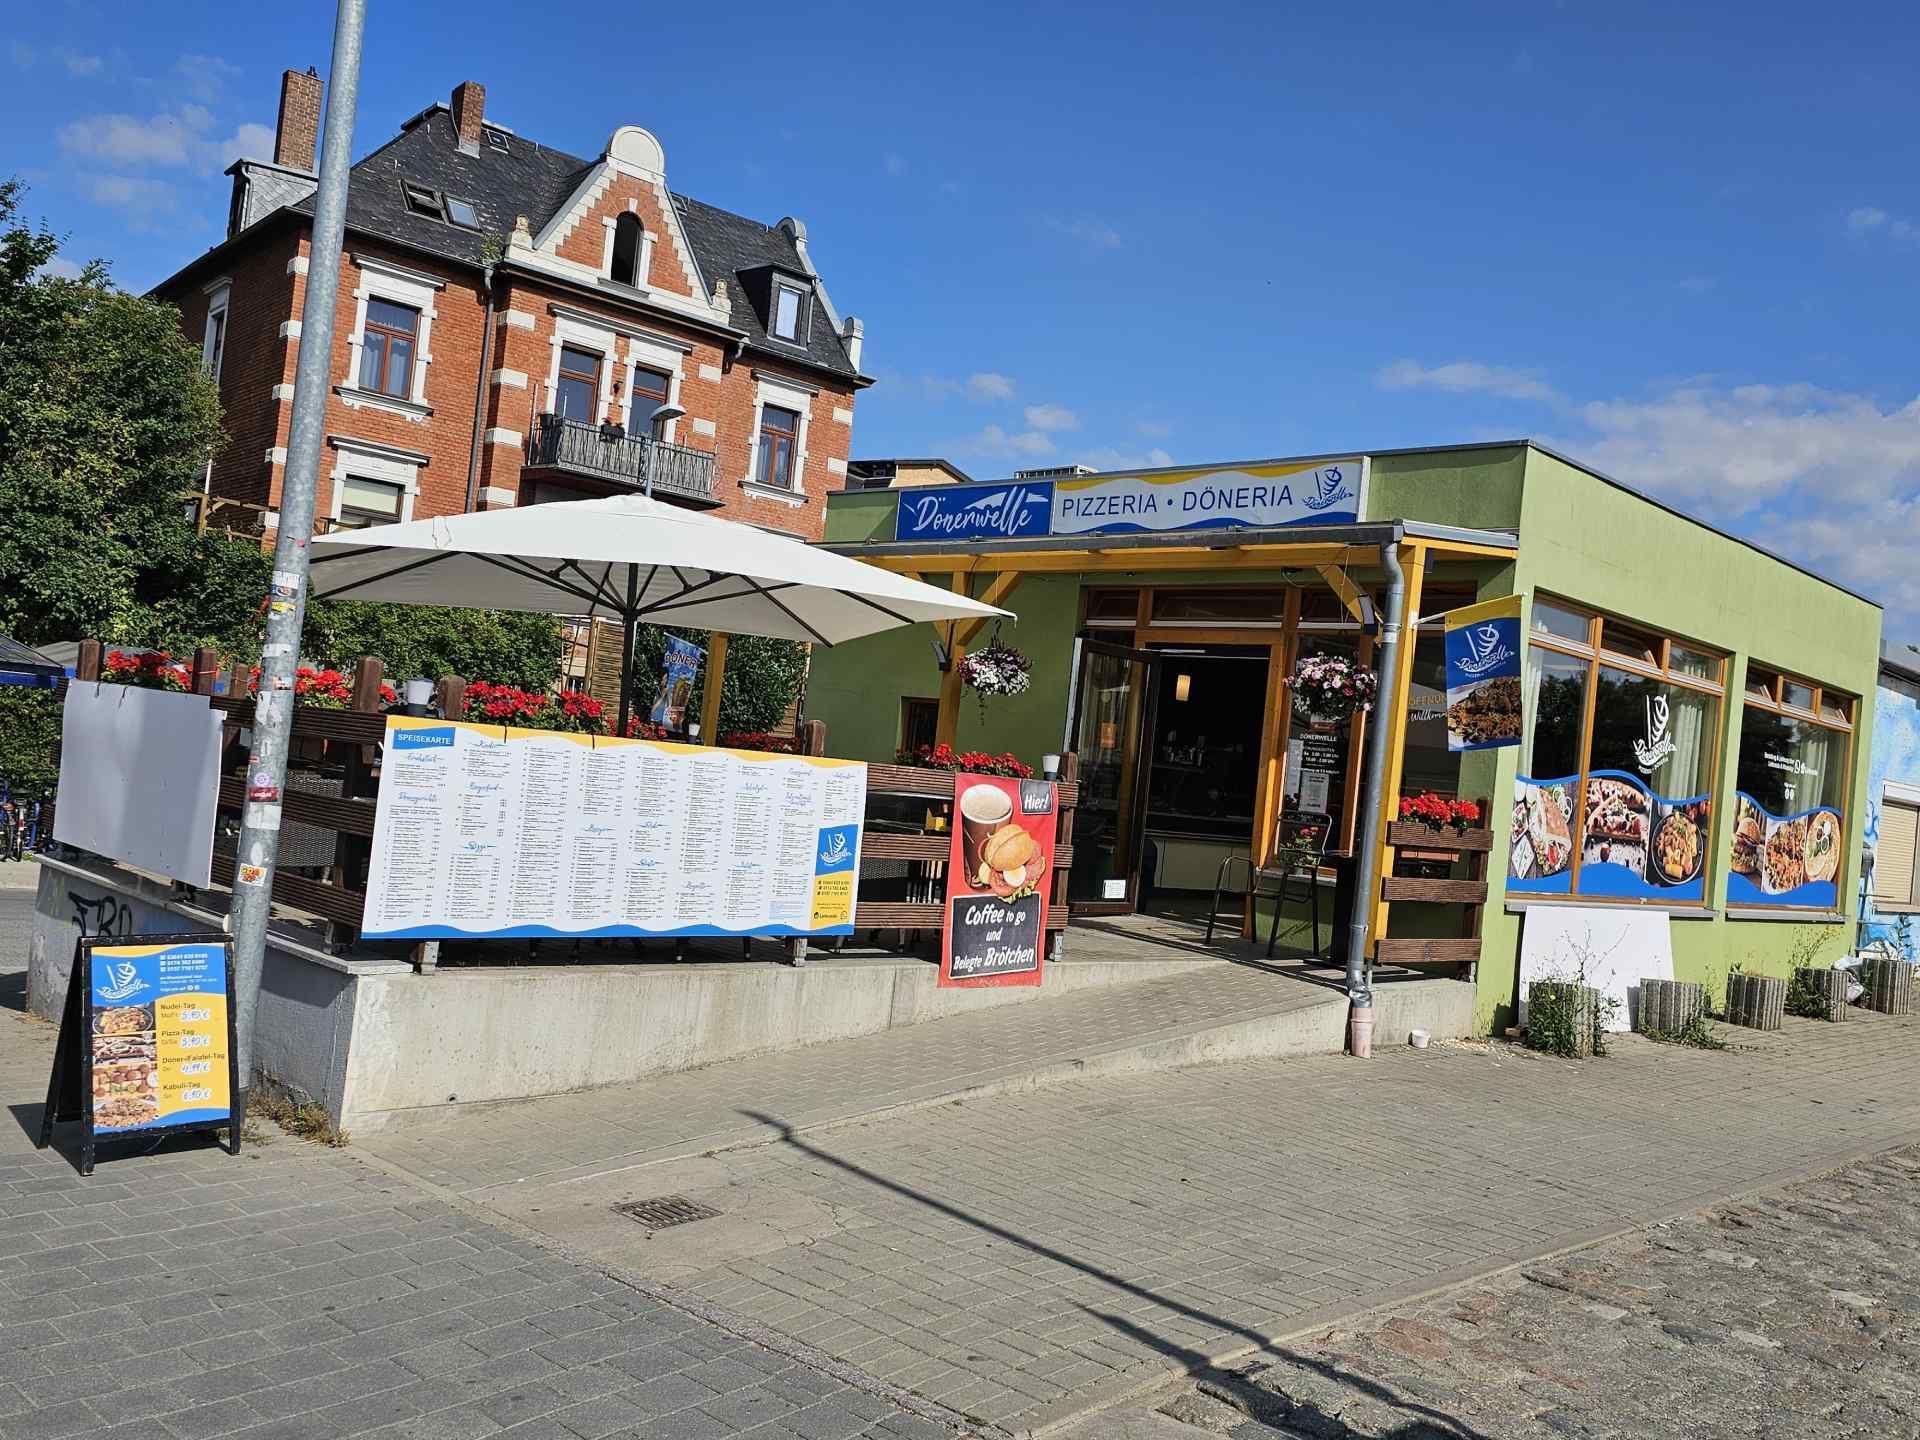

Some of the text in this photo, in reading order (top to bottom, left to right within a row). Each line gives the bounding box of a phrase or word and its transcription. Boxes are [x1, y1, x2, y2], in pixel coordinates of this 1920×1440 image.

[912, 485, 1032, 536] Dönerwelle
[1062, 484, 1293, 517] PIZZERIA DÖNERIA
[397, 733, 452, 745] SPEISEKARTE
[1024, 792, 1050, 810] Hier!
[965, 903, 1026, 926] Coffee to go
[985, 927, 1003, 942] und
[953, 944, 1035, 972] Belegte Brötchen
[161, 1029, 195, 1037] Pizza-Tag
